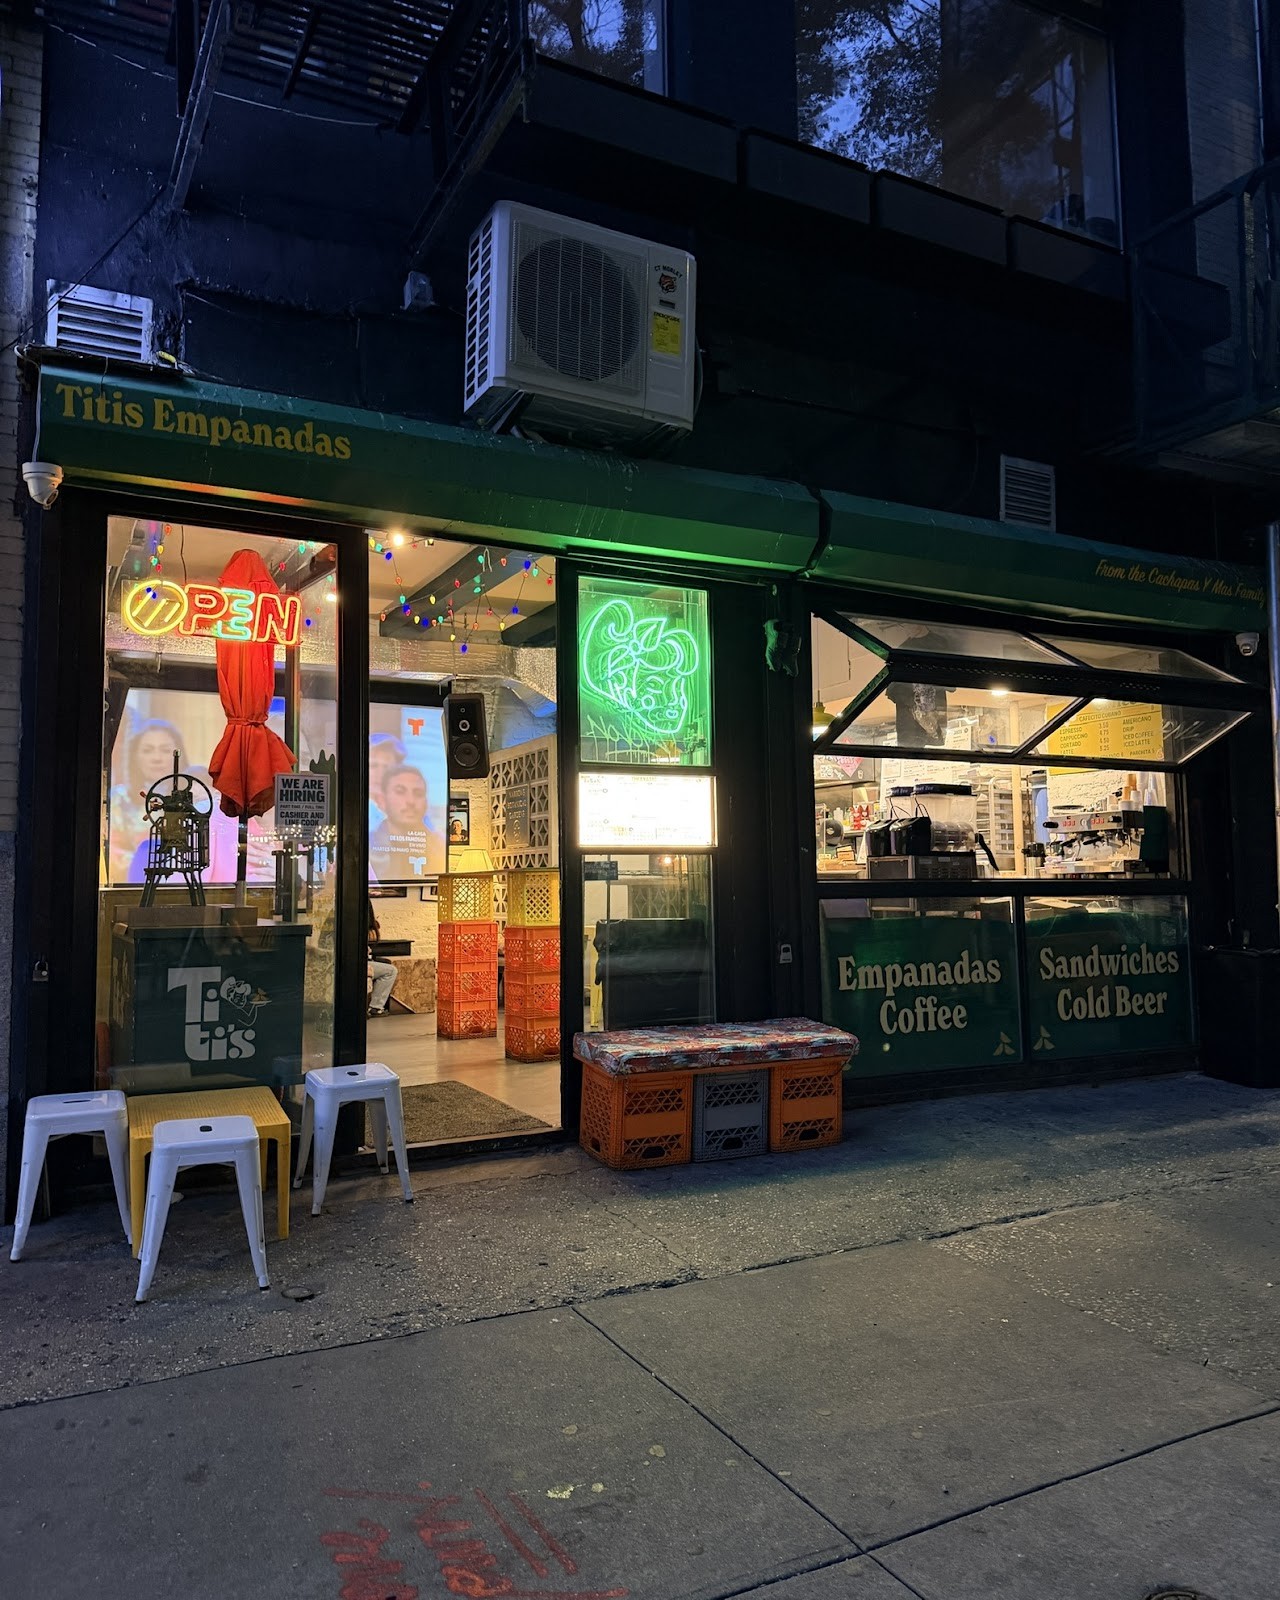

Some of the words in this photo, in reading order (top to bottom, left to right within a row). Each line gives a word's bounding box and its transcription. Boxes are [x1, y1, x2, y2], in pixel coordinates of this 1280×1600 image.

[55, 383, 144, 428] Titis
[152, 398, 352, 460] Empanadas
[1095, 560, 1125, 579] From
[1128, 565, 1145, 582] the
[1148, 568, 1200, 592] Cachapas
[1203, 577, 1213, 592] Y
[1211, 580, 1232, 596] Mas
[1235, 583, 1266, 608] Family
[125, 580, 301, 645] OPEN
[1060, 727, 1082, 735] ESPRESSO
[1123, 715, 1152, 725] AMERICANO
[1060, 733, 1088, 742] CAPPUCCINO
[1060, 741, 1082, 749] CORTADO
[281, 778, 300, 789] WE
[302, 779, 324, 789] ARE
[280, 790, 325, 802] HIRING
[280, 811, 309, 819] CASHIER
[310, 811, 324, 819] AND
[1040, 942, 1180, 980] Sandwiches
[838, 949, 1001, 998] Empanadas
[879, 995, 968, 1035] Coffee
[1057, 985, 1111, 1021] Cold
[1114, 986, 1168, 1017] Beer
